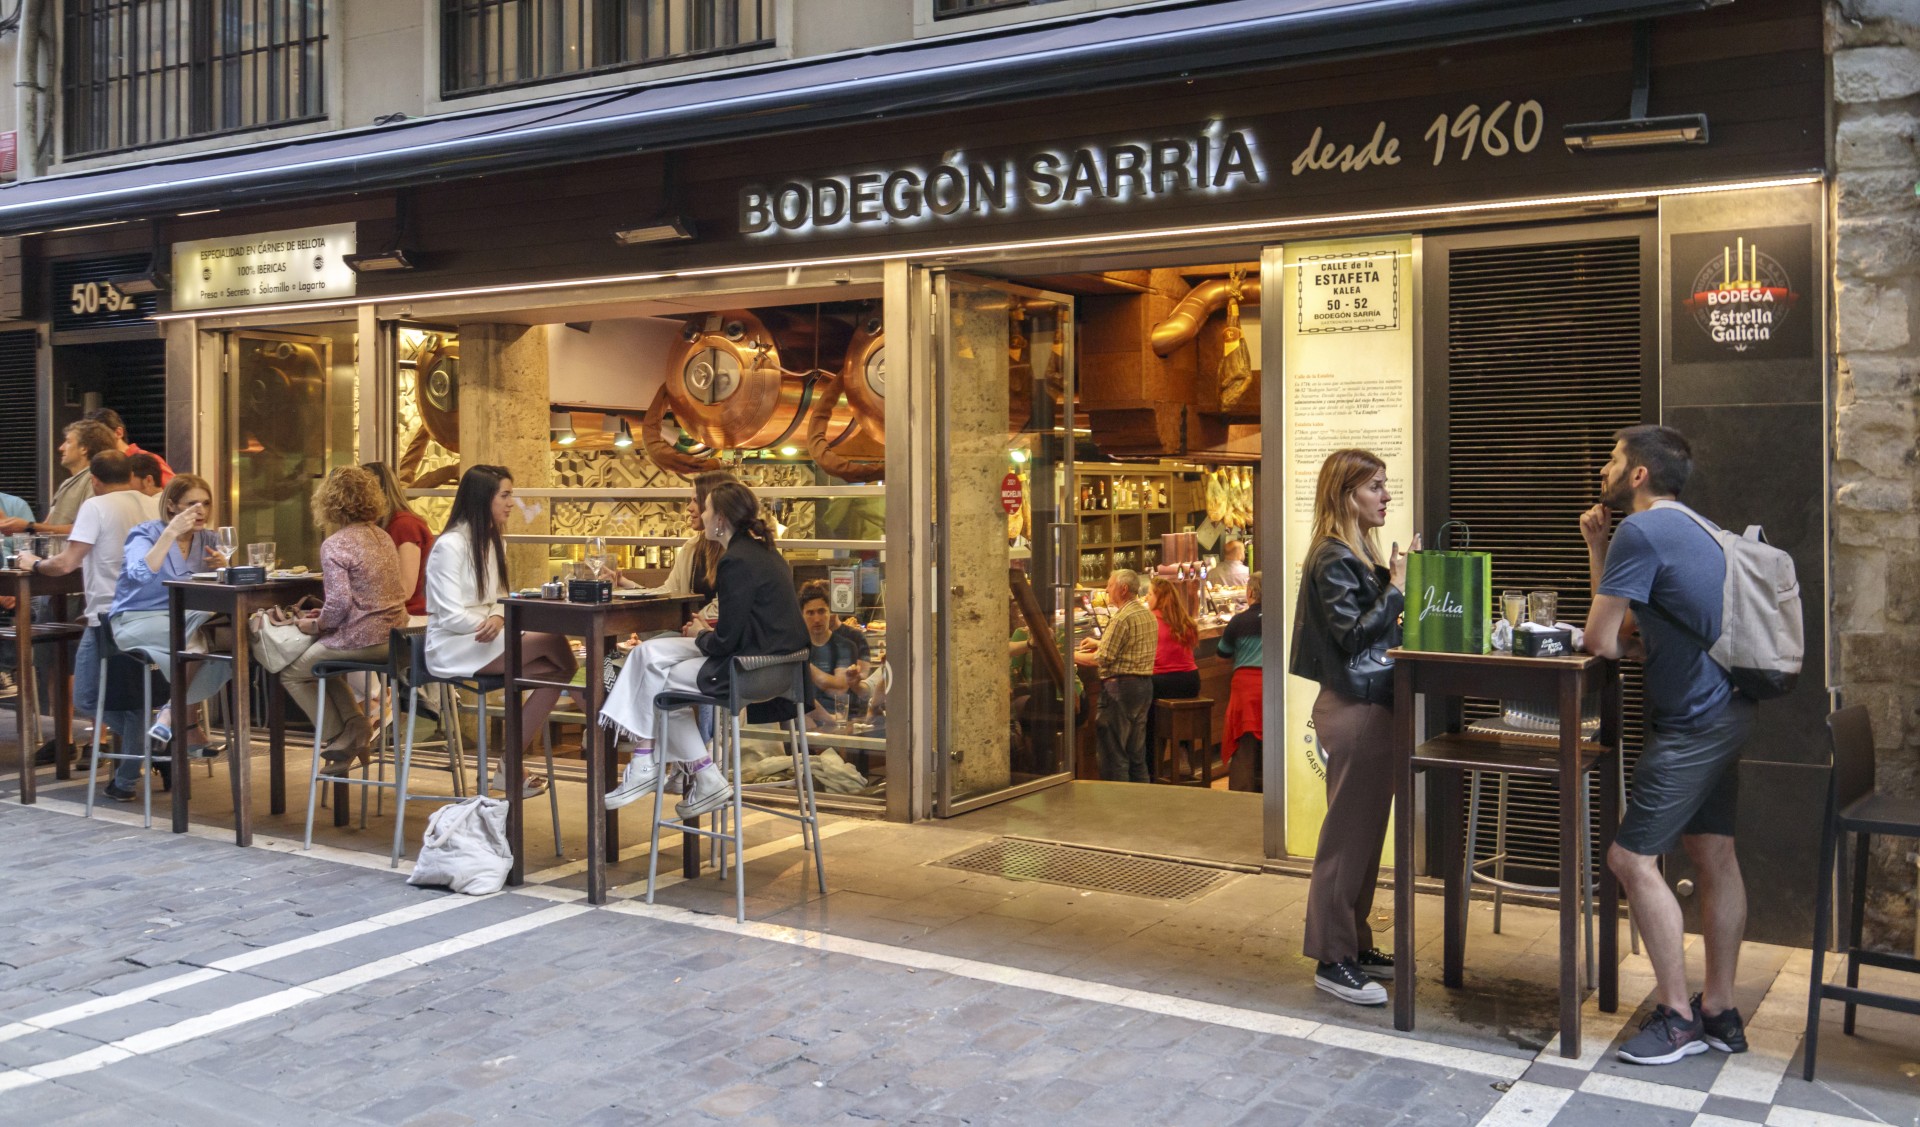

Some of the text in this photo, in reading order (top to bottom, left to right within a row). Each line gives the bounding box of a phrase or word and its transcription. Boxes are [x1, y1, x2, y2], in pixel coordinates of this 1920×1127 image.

[1291, 100, 1544, 175] desde 1960
[739, 119, 1260, 233] BODEGÓN SARRÍA
[200, 238, 325, 260] ESPECIALIDAD EN CARNES DE BELLOTA
[237, 266, 256, 276] 100%
[1321, 262, 1347, 271] CALLE
[1315, 271, 1380, 286] ESTAFETA
[200, 281, 325, 299] Presa Secreto Solomillo Lagarto
[1334, 286, 1360, 295] KALEA
[1708, 290, 1774, 305] BODEGA
[1327, 299, 1340, 310] 50
[1354, 298, 1368, 309] 52
[1314, 309, 1381, 319] BODEGÓN SARRÍA
[1709, 308, 1772, 326] Estrella
[1712, 324, 1770, 342] Galicia
[1419, 586, 1464, 621] Júlia
[1306, 750, 1327, 780] GASTR
